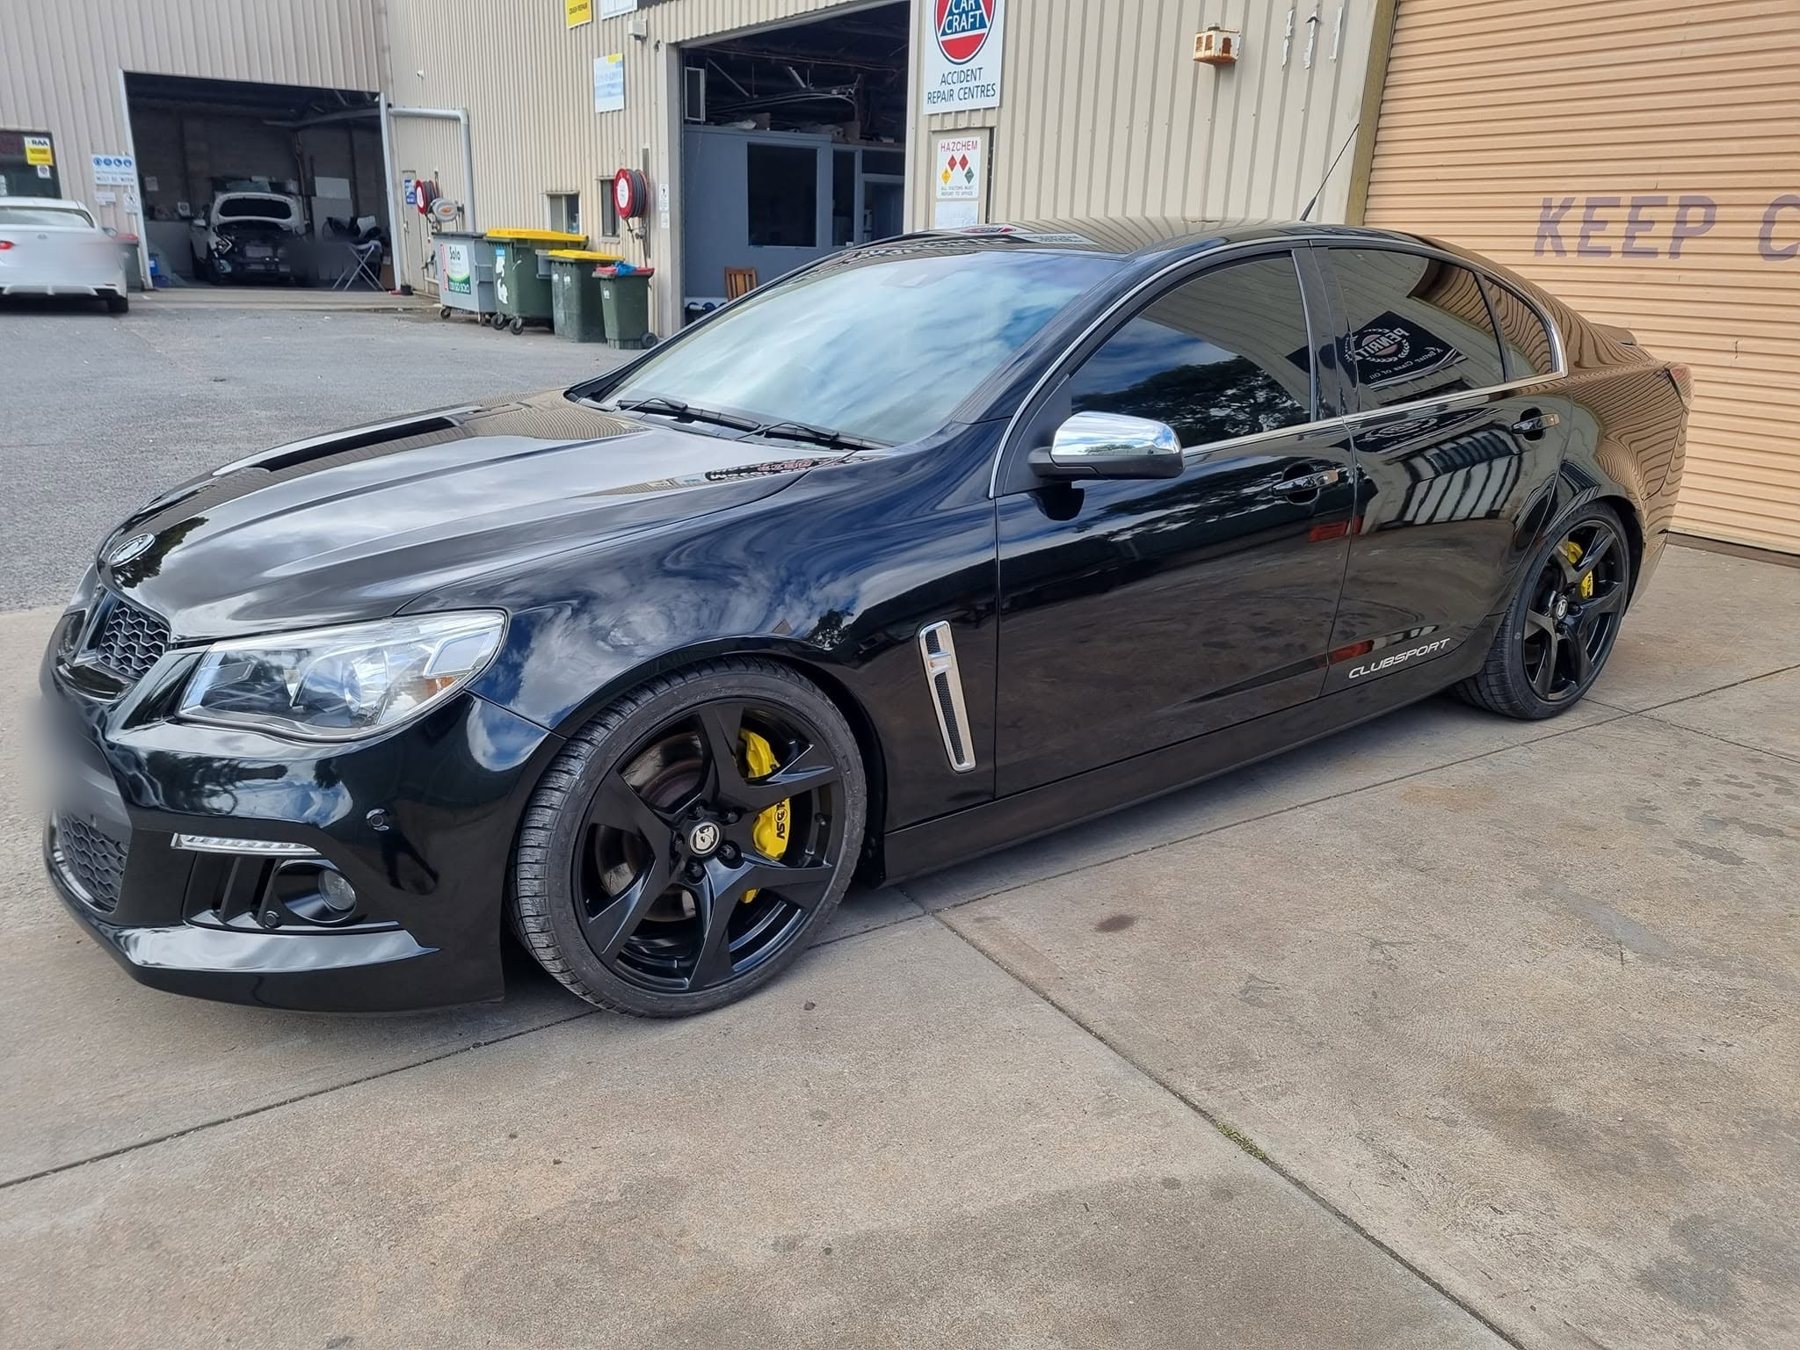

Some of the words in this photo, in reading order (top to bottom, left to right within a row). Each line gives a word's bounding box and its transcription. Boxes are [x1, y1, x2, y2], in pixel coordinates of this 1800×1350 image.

[951, 0, 976, 13] CAR
[945, 12, 982, 33] CRAFT
[940, 67, 983, 86] ACCIDENT
[927, 89, 954, 104] REPAIR
[958, 83, 996, 101] CENTRES
[940, 140, 977, 152] HAZCHEM
[1534, 195, 1718, 260] KEEP
[1348, 638, 1450, 679] CLUBSPORT
